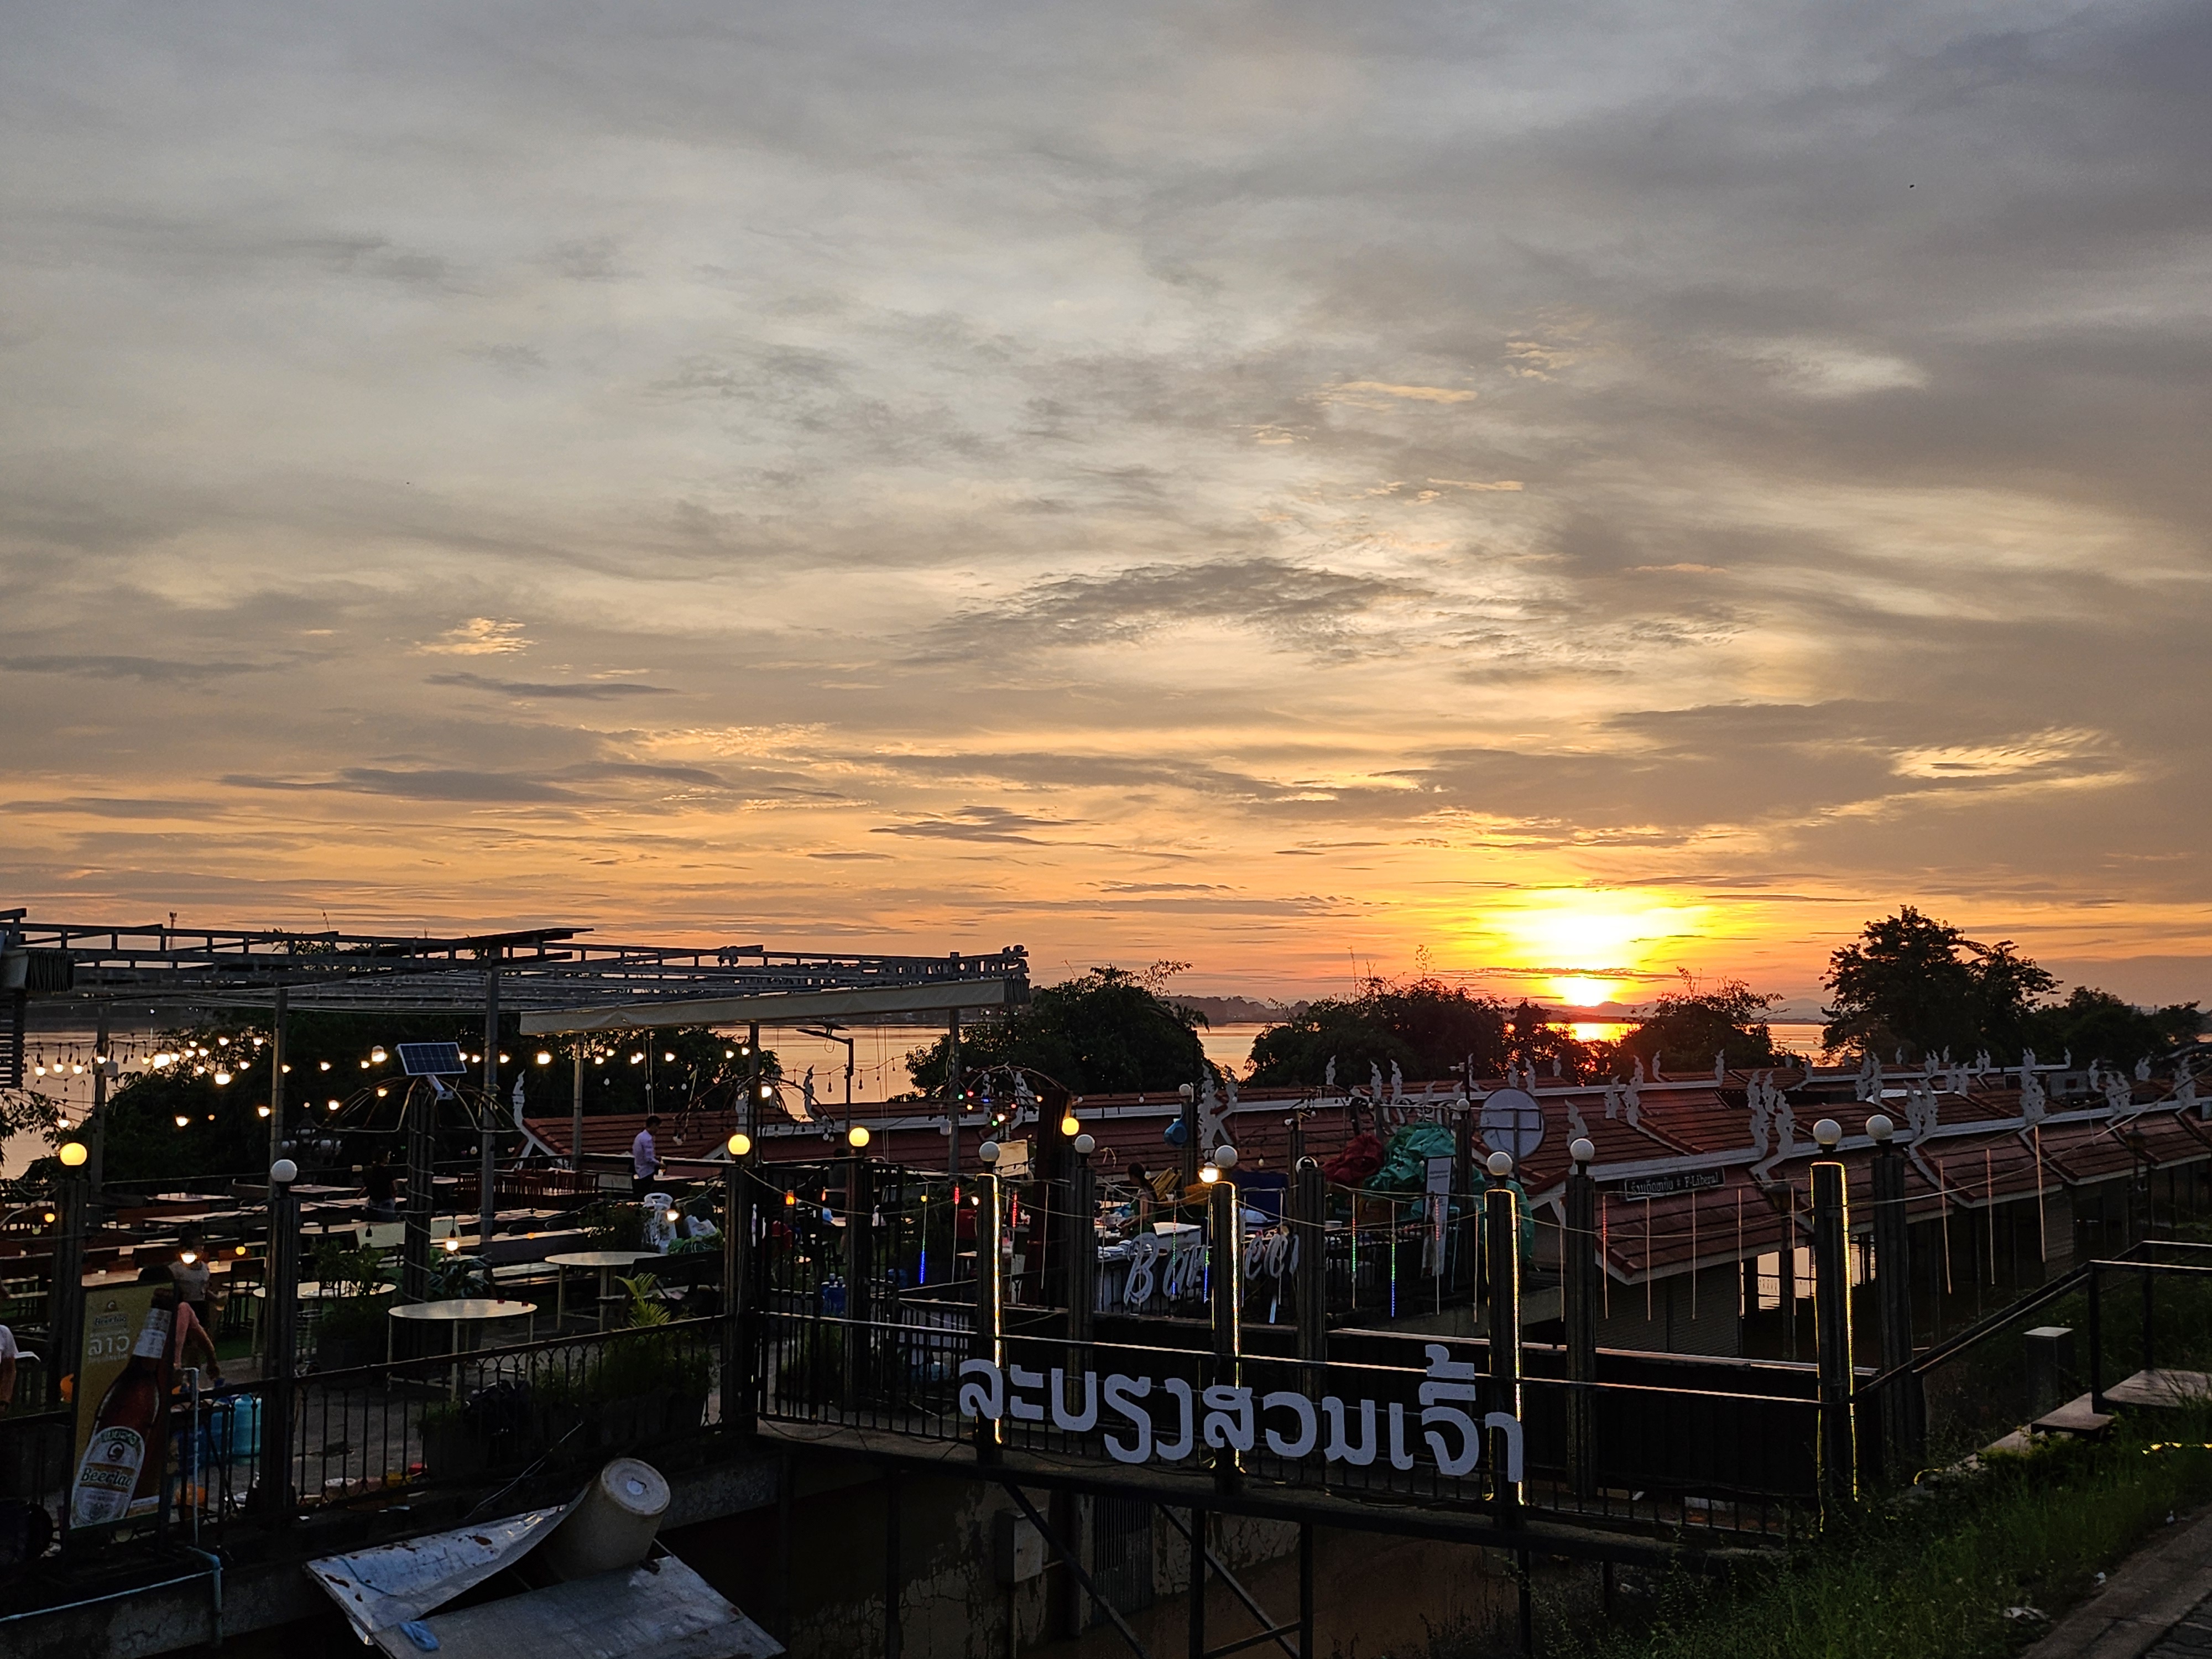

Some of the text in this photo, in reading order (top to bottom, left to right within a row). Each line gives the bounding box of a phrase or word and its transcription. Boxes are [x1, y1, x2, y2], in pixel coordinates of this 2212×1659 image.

[959, 1344, 1524, 1483] ລະບຽງສວນເຈົ້າ
[81, 1467, 133, 1486] Beerlao
